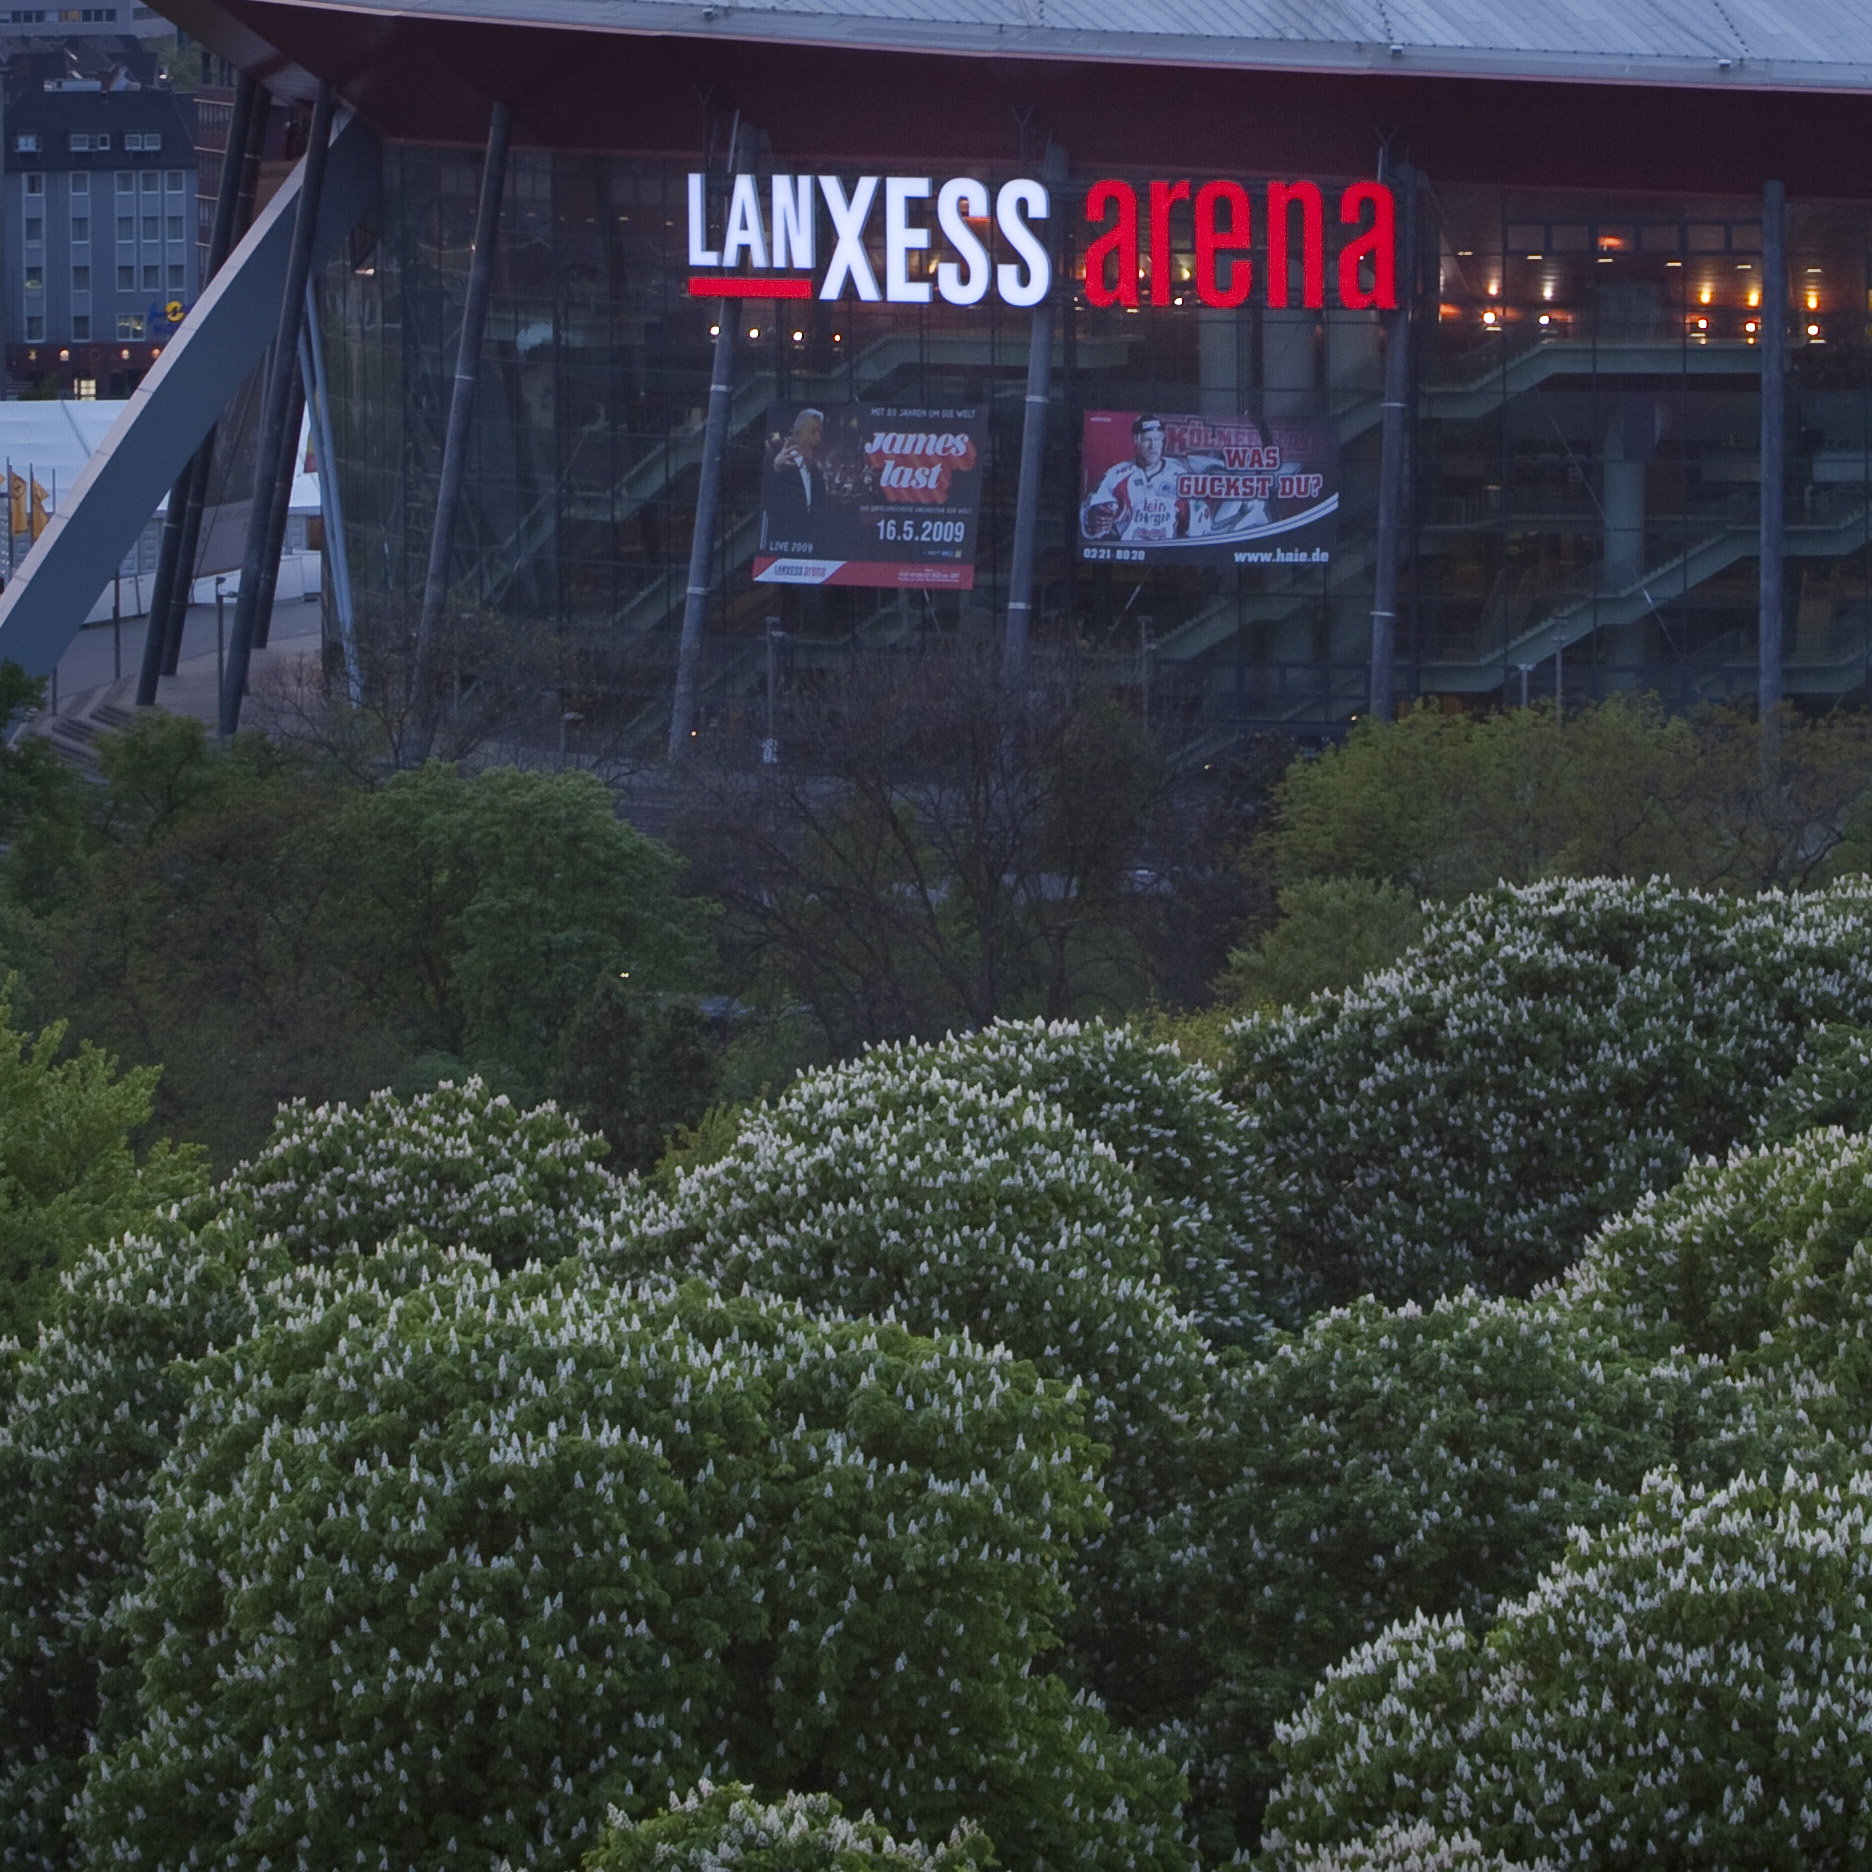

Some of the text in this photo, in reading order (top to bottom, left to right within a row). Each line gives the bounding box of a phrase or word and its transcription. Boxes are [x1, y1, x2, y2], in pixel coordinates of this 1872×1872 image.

[688, 173, 1396, 310] LANXESS arena
[899, 409, 927, 418] JAHREN
[929, 409, 940, 418] UM
[956, 409, 976, 419] WELT
[1224, 447, 1279, 470] WAS
[880, 460, 942, 489] last
[1178, 474, 1323, 499] GUCKST DU?
[877, 519, 965, 542] 16.5.2009
[769, 541, 814, 554] LIVE 2009
[1234, 547, 1330, 563] www.haie.de
